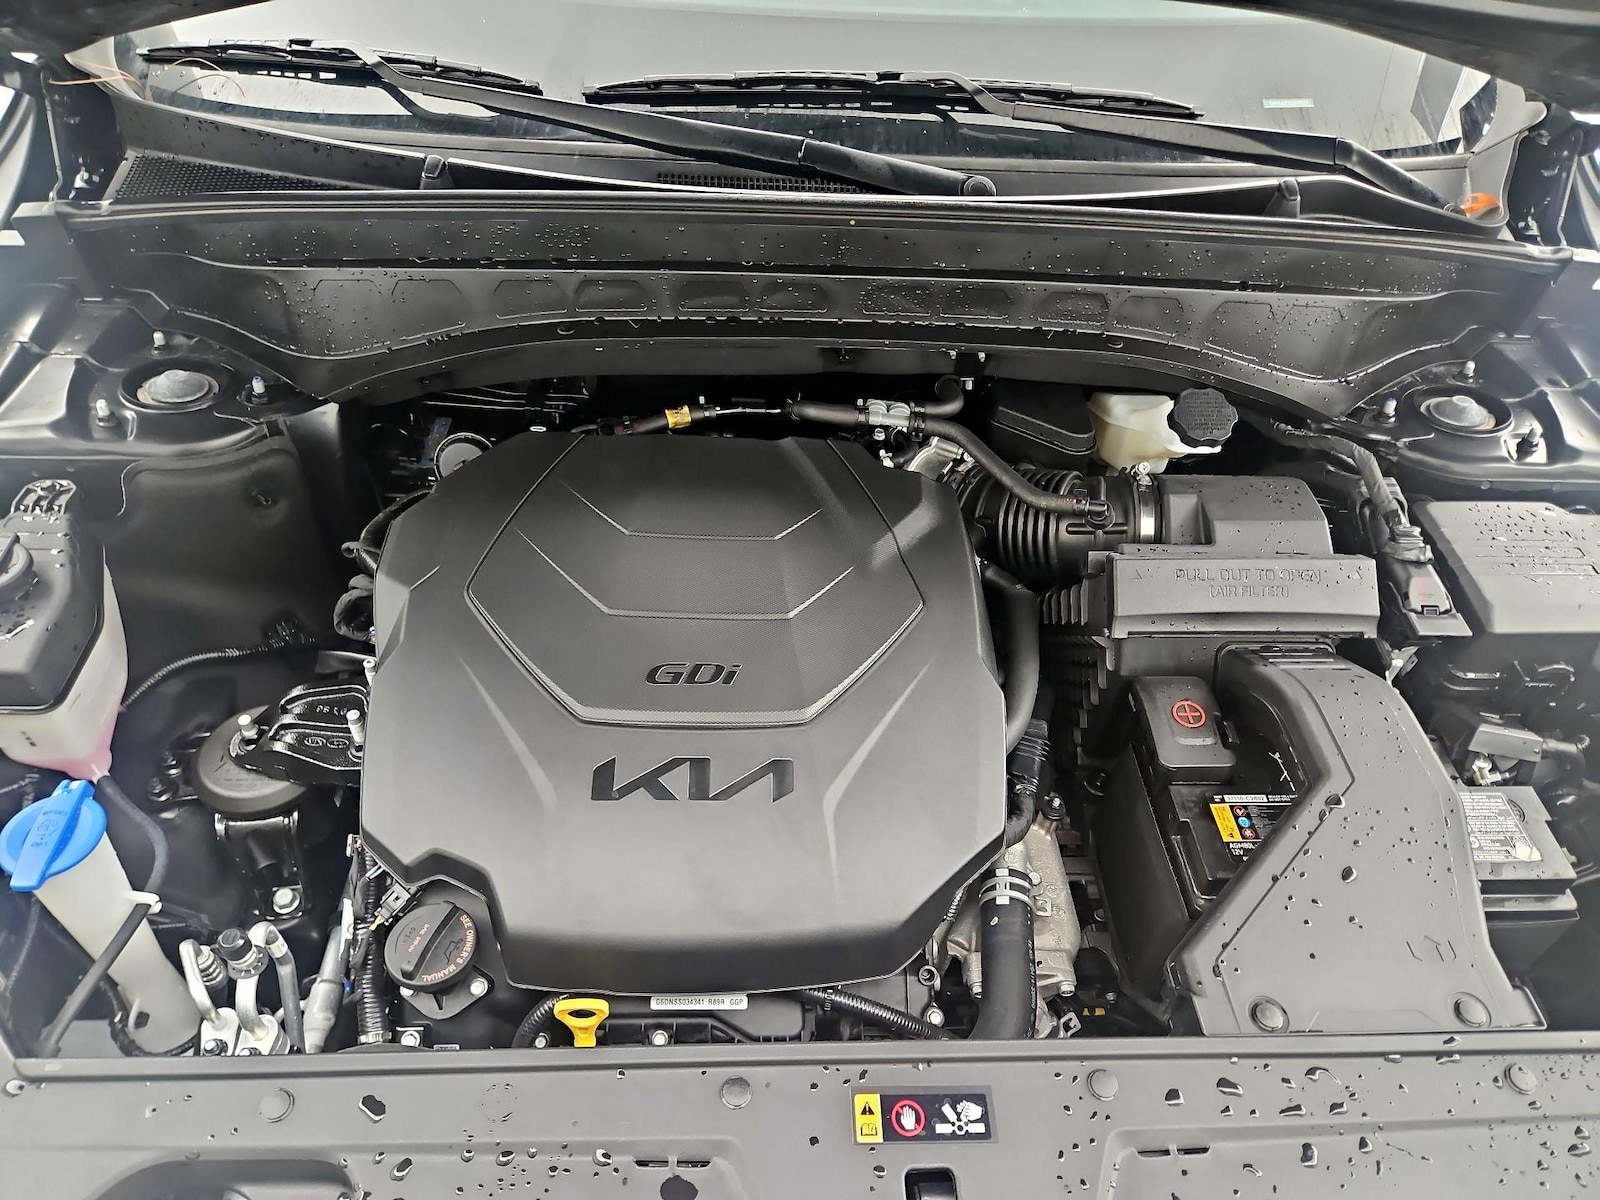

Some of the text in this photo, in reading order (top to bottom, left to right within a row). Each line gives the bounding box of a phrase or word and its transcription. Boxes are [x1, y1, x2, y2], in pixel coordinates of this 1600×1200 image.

[1175, 568, 1321, 583] PULL OUT TO OPEN
[646, 662, 742, 685] GDi
[591, 755, 794, 802] KIA
[422, 914, 474, 982] SEE OWNER'S MANUAL
